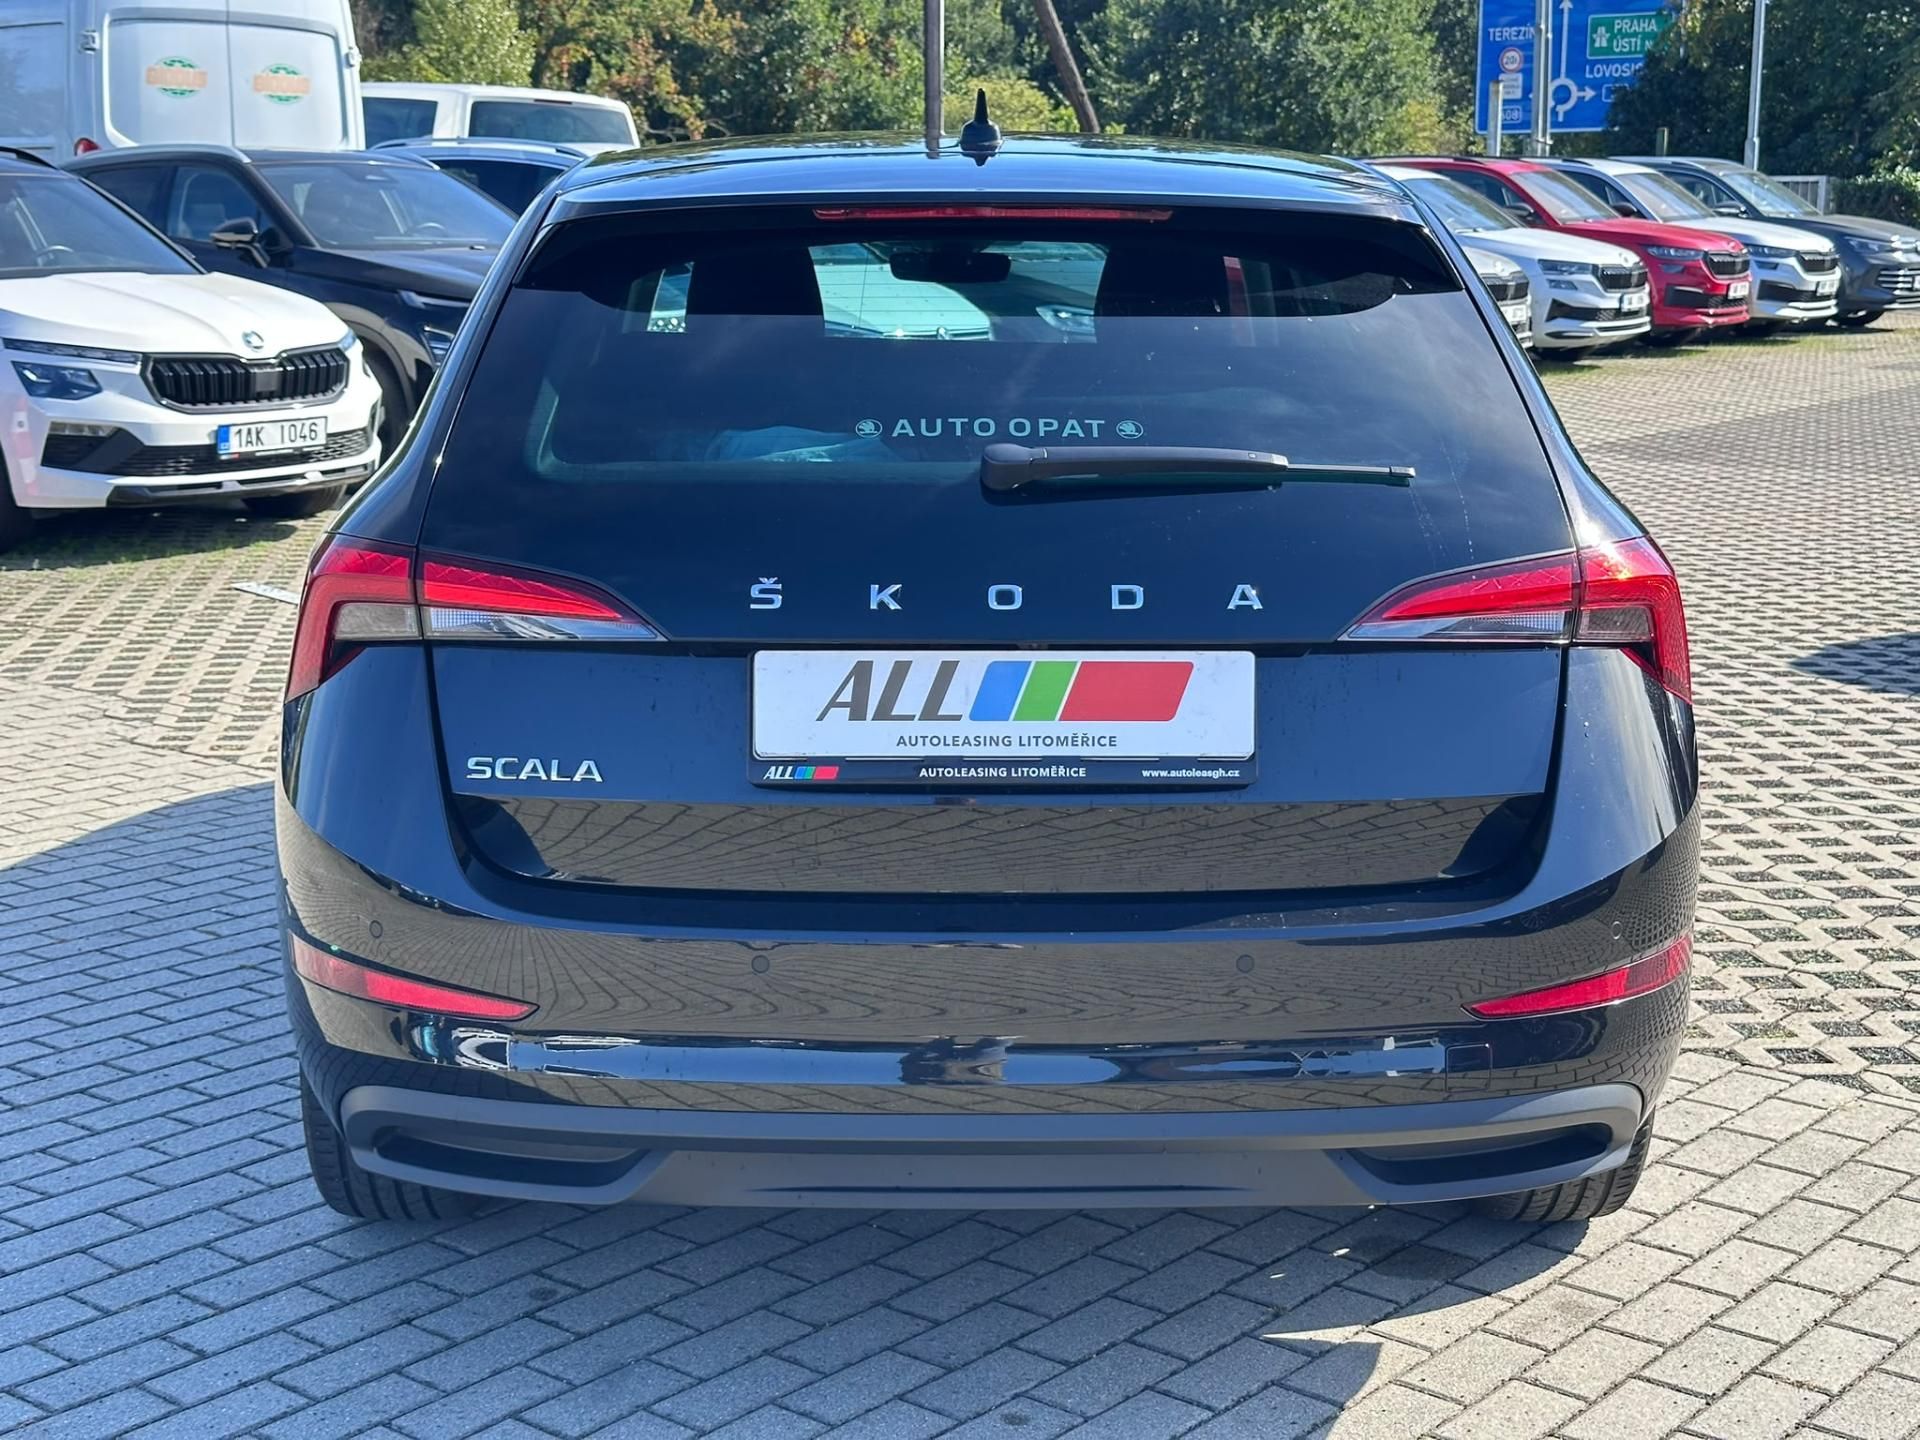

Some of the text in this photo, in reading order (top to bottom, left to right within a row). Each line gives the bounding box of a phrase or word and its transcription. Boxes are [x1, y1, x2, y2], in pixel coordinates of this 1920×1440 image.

[1614, 18, 1657, 33] PRAHA
[1613, 35, 1642, 52] ÚSTÍ
[891, 418, 1105, 438] AUTO OPAT
[235, 426, 264, 448] 1AK
[749, 577, 1263, 610] ŠKODA
[815, 660, 963, 721] ALL
[896, 733, 1117, 747] AUTOLEASING LITOMĚŘICE
[466, 756, 603, 783] SCALA
[763, 766, 794, 780] ALL
[919, 766, 1087, 778] AUTOLEASING LITOMĚŘICE
[1142, 768, 1240, 780] www.autoleasgh.cz
